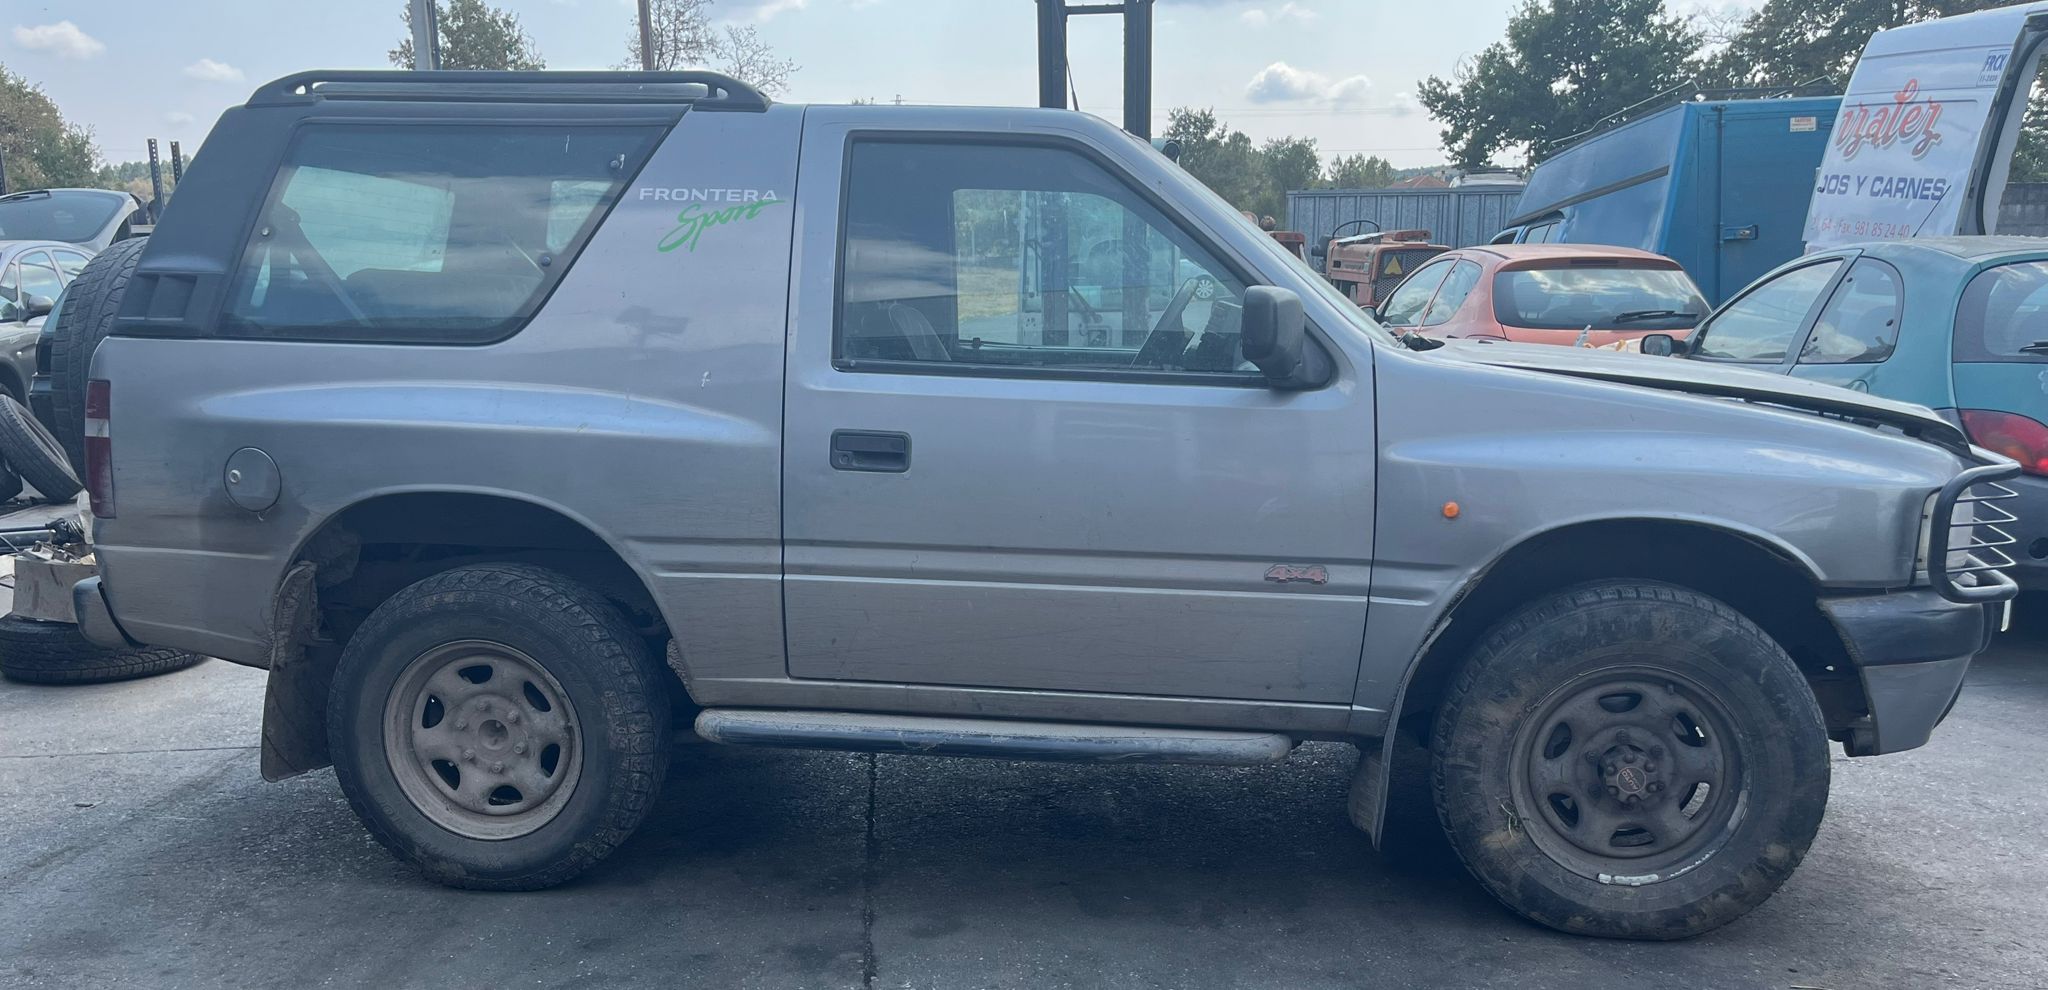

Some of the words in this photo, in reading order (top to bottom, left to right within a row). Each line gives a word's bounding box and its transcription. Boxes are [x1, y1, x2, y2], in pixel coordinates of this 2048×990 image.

[639, 187, 777, 202] FRONTERA
[1855, 175, 1868, 196] Y
[1870, 176, 1947, 200] CARNES
[656, 200, 786, 252] Sport
[1855, 220, 1870, 236] 981
[1871, 222, 1883, 237] 85
[1884, 223, 1896, 239] 24
[1897, 223, 1910, 239] 40
